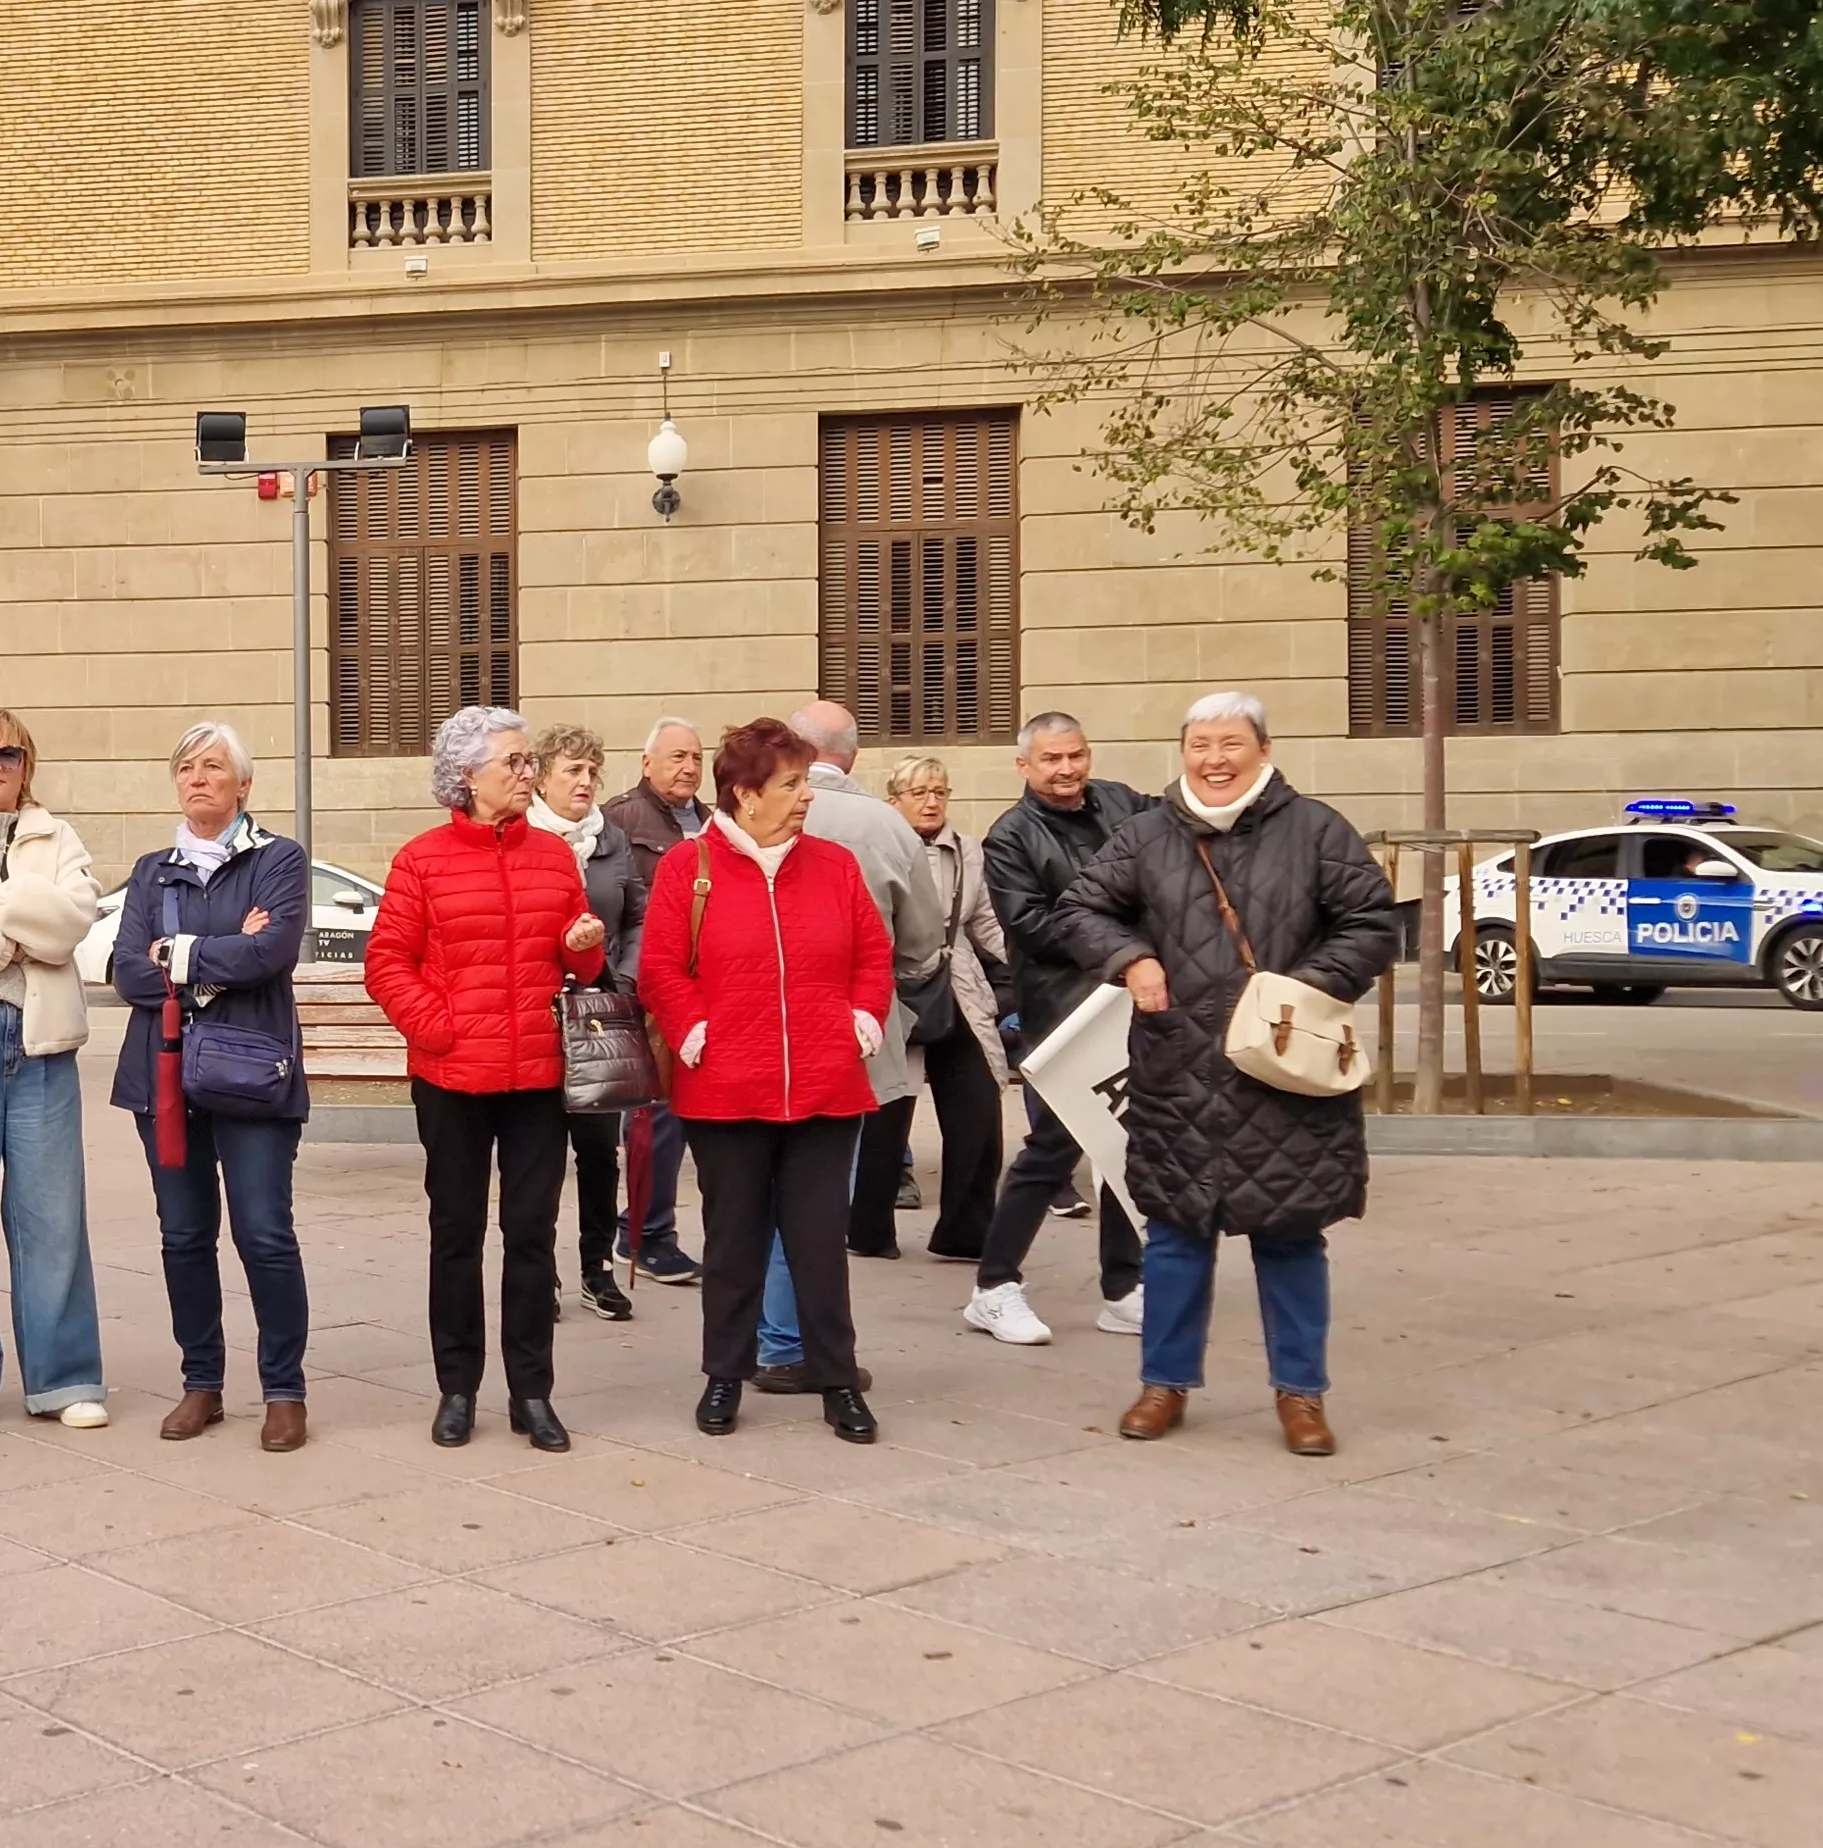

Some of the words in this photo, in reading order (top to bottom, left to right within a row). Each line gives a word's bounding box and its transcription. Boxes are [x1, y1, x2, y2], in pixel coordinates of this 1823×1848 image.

[318, 930, 355, 939] ARAGÓN
[1563, 931, 1622, 944] HUESCA
[1636, 921, 1740, 944] POLICIA
[318, 939, 331, 947] TV
